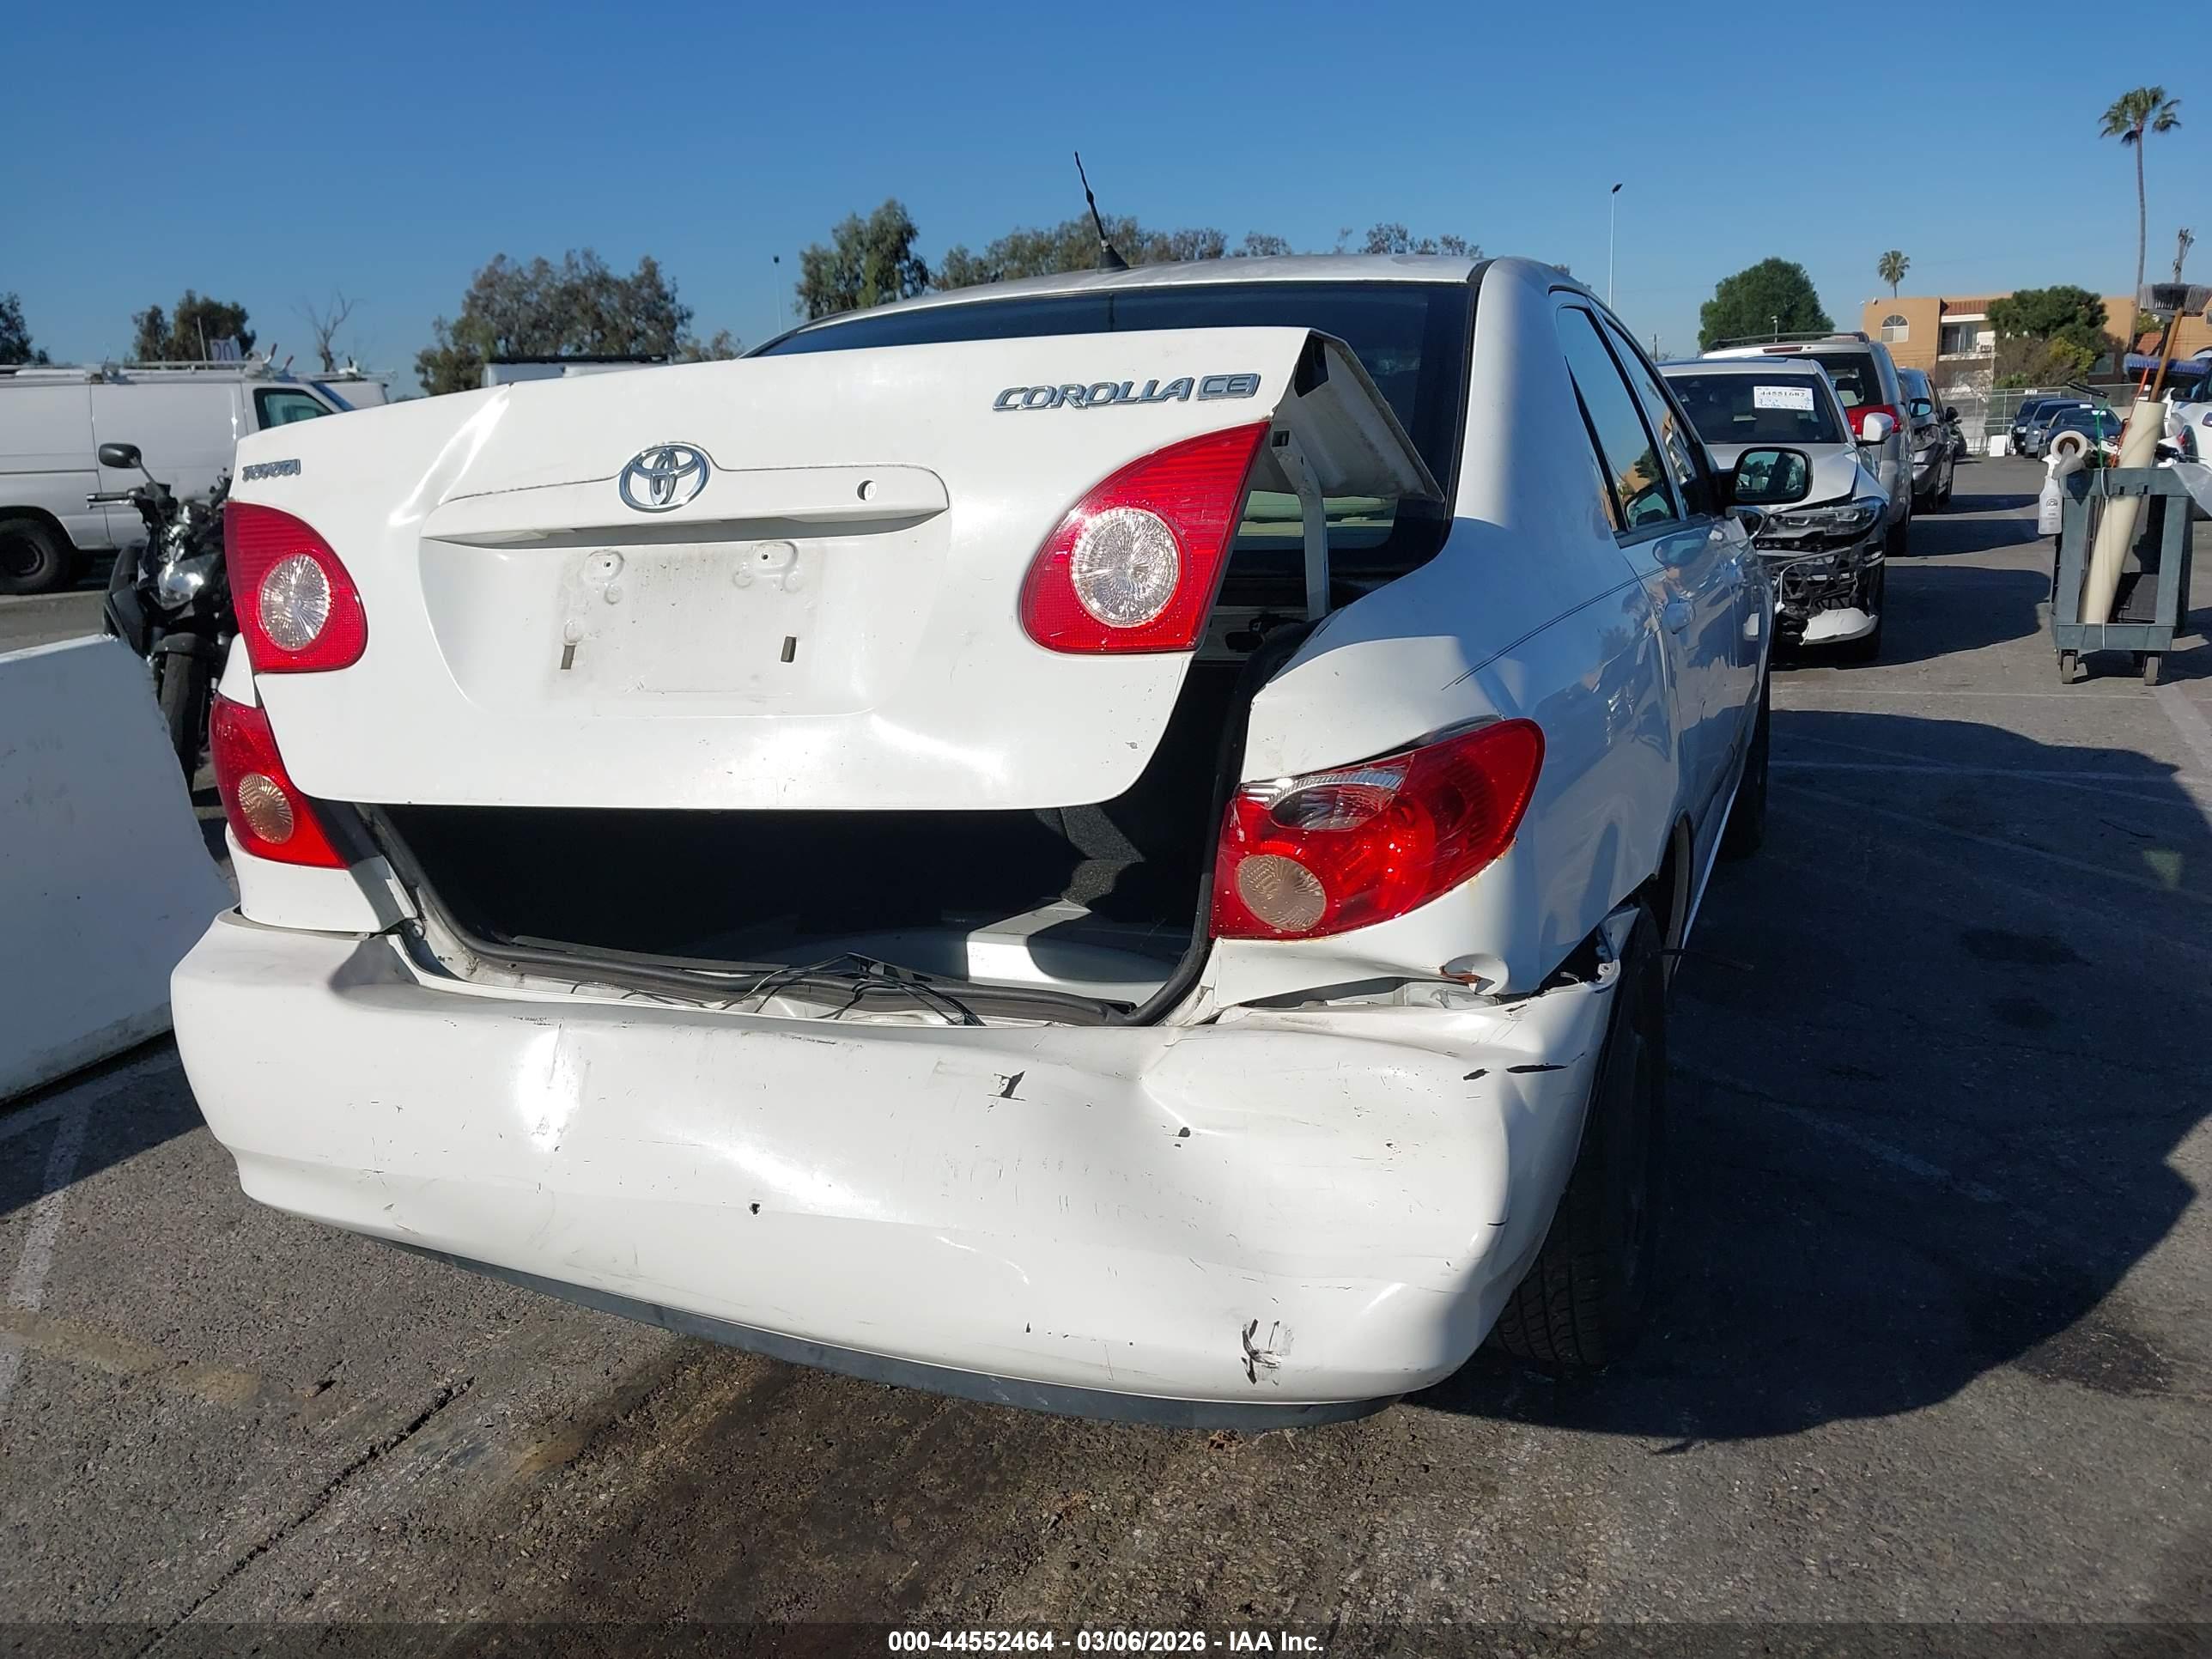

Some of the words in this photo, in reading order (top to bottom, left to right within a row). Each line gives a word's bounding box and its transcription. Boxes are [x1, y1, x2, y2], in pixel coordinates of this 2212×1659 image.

[992, 376, 1195, 411] COROLLA
[1196, 373, 1261, 401] CE
[242, 459, 301, 483] TOYOTA
